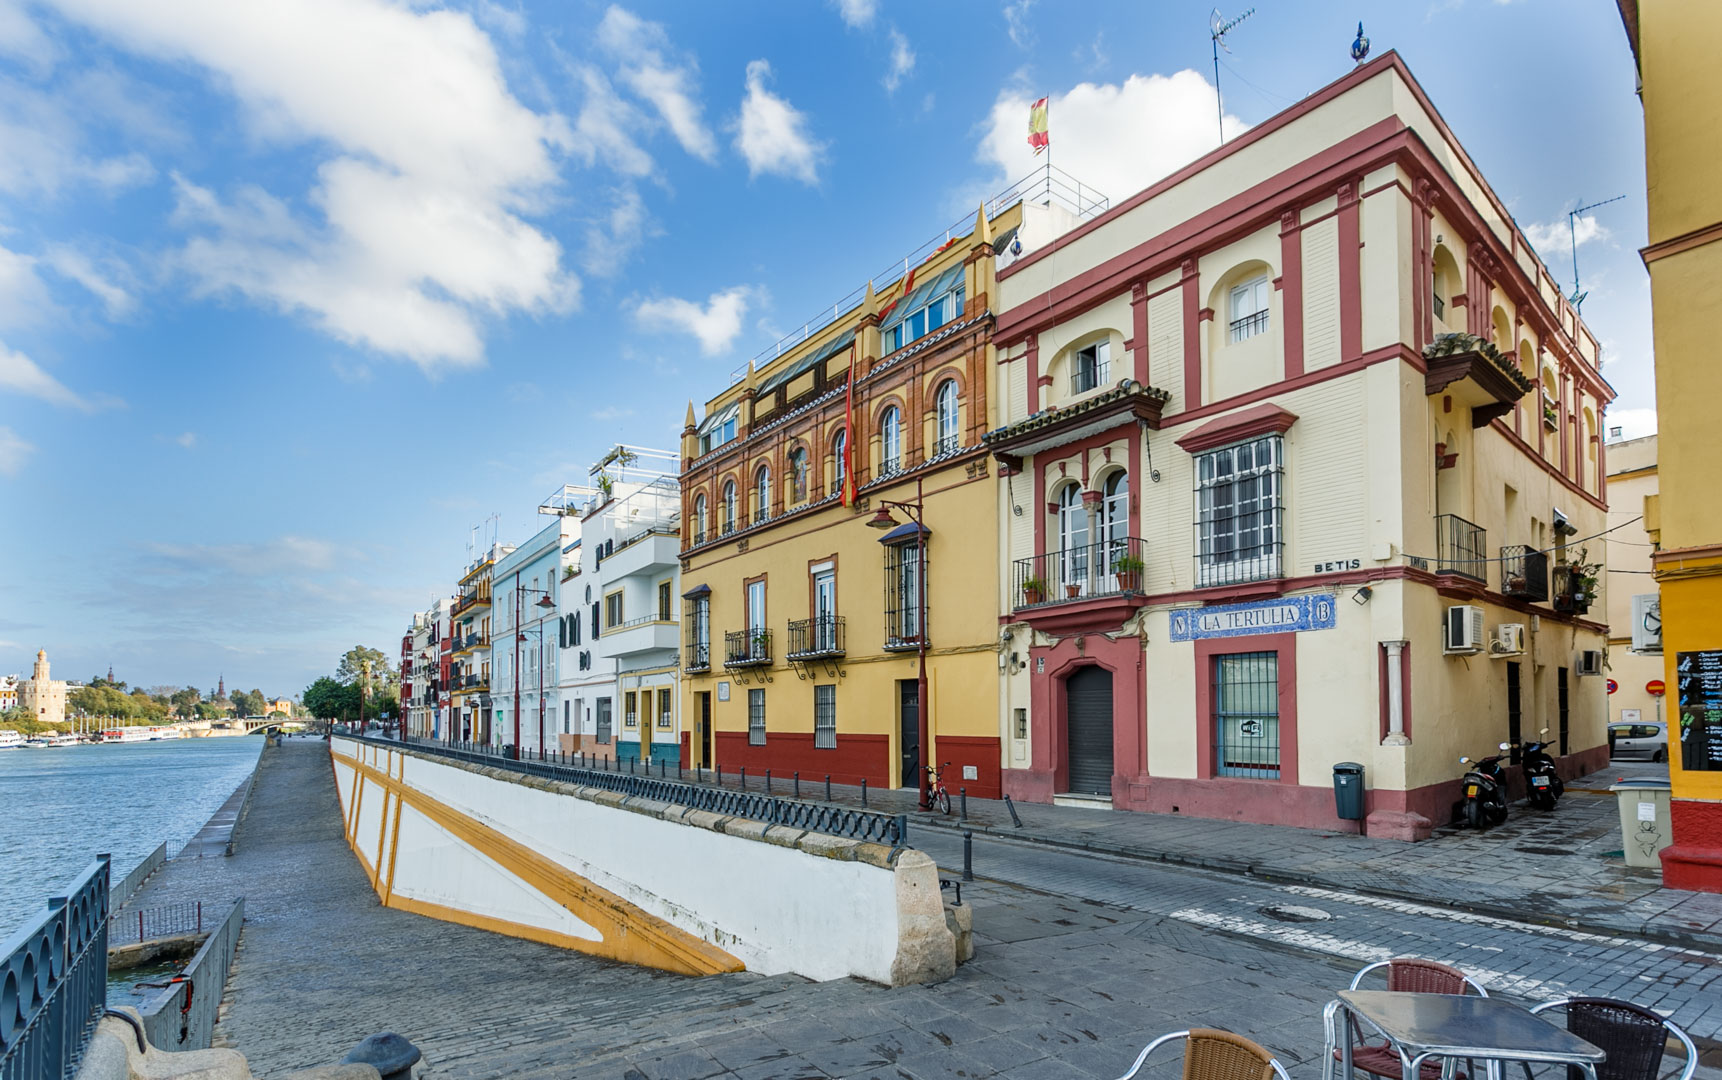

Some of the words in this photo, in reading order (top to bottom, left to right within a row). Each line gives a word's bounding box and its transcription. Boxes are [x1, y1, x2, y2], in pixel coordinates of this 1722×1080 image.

[1314, 559, 1360, 573] BETIS
[1204, 615, 1221, 630] LA
[1226, 607, 1295, 629] TERTULIA
[1318, 603, 1328, 620] 13
